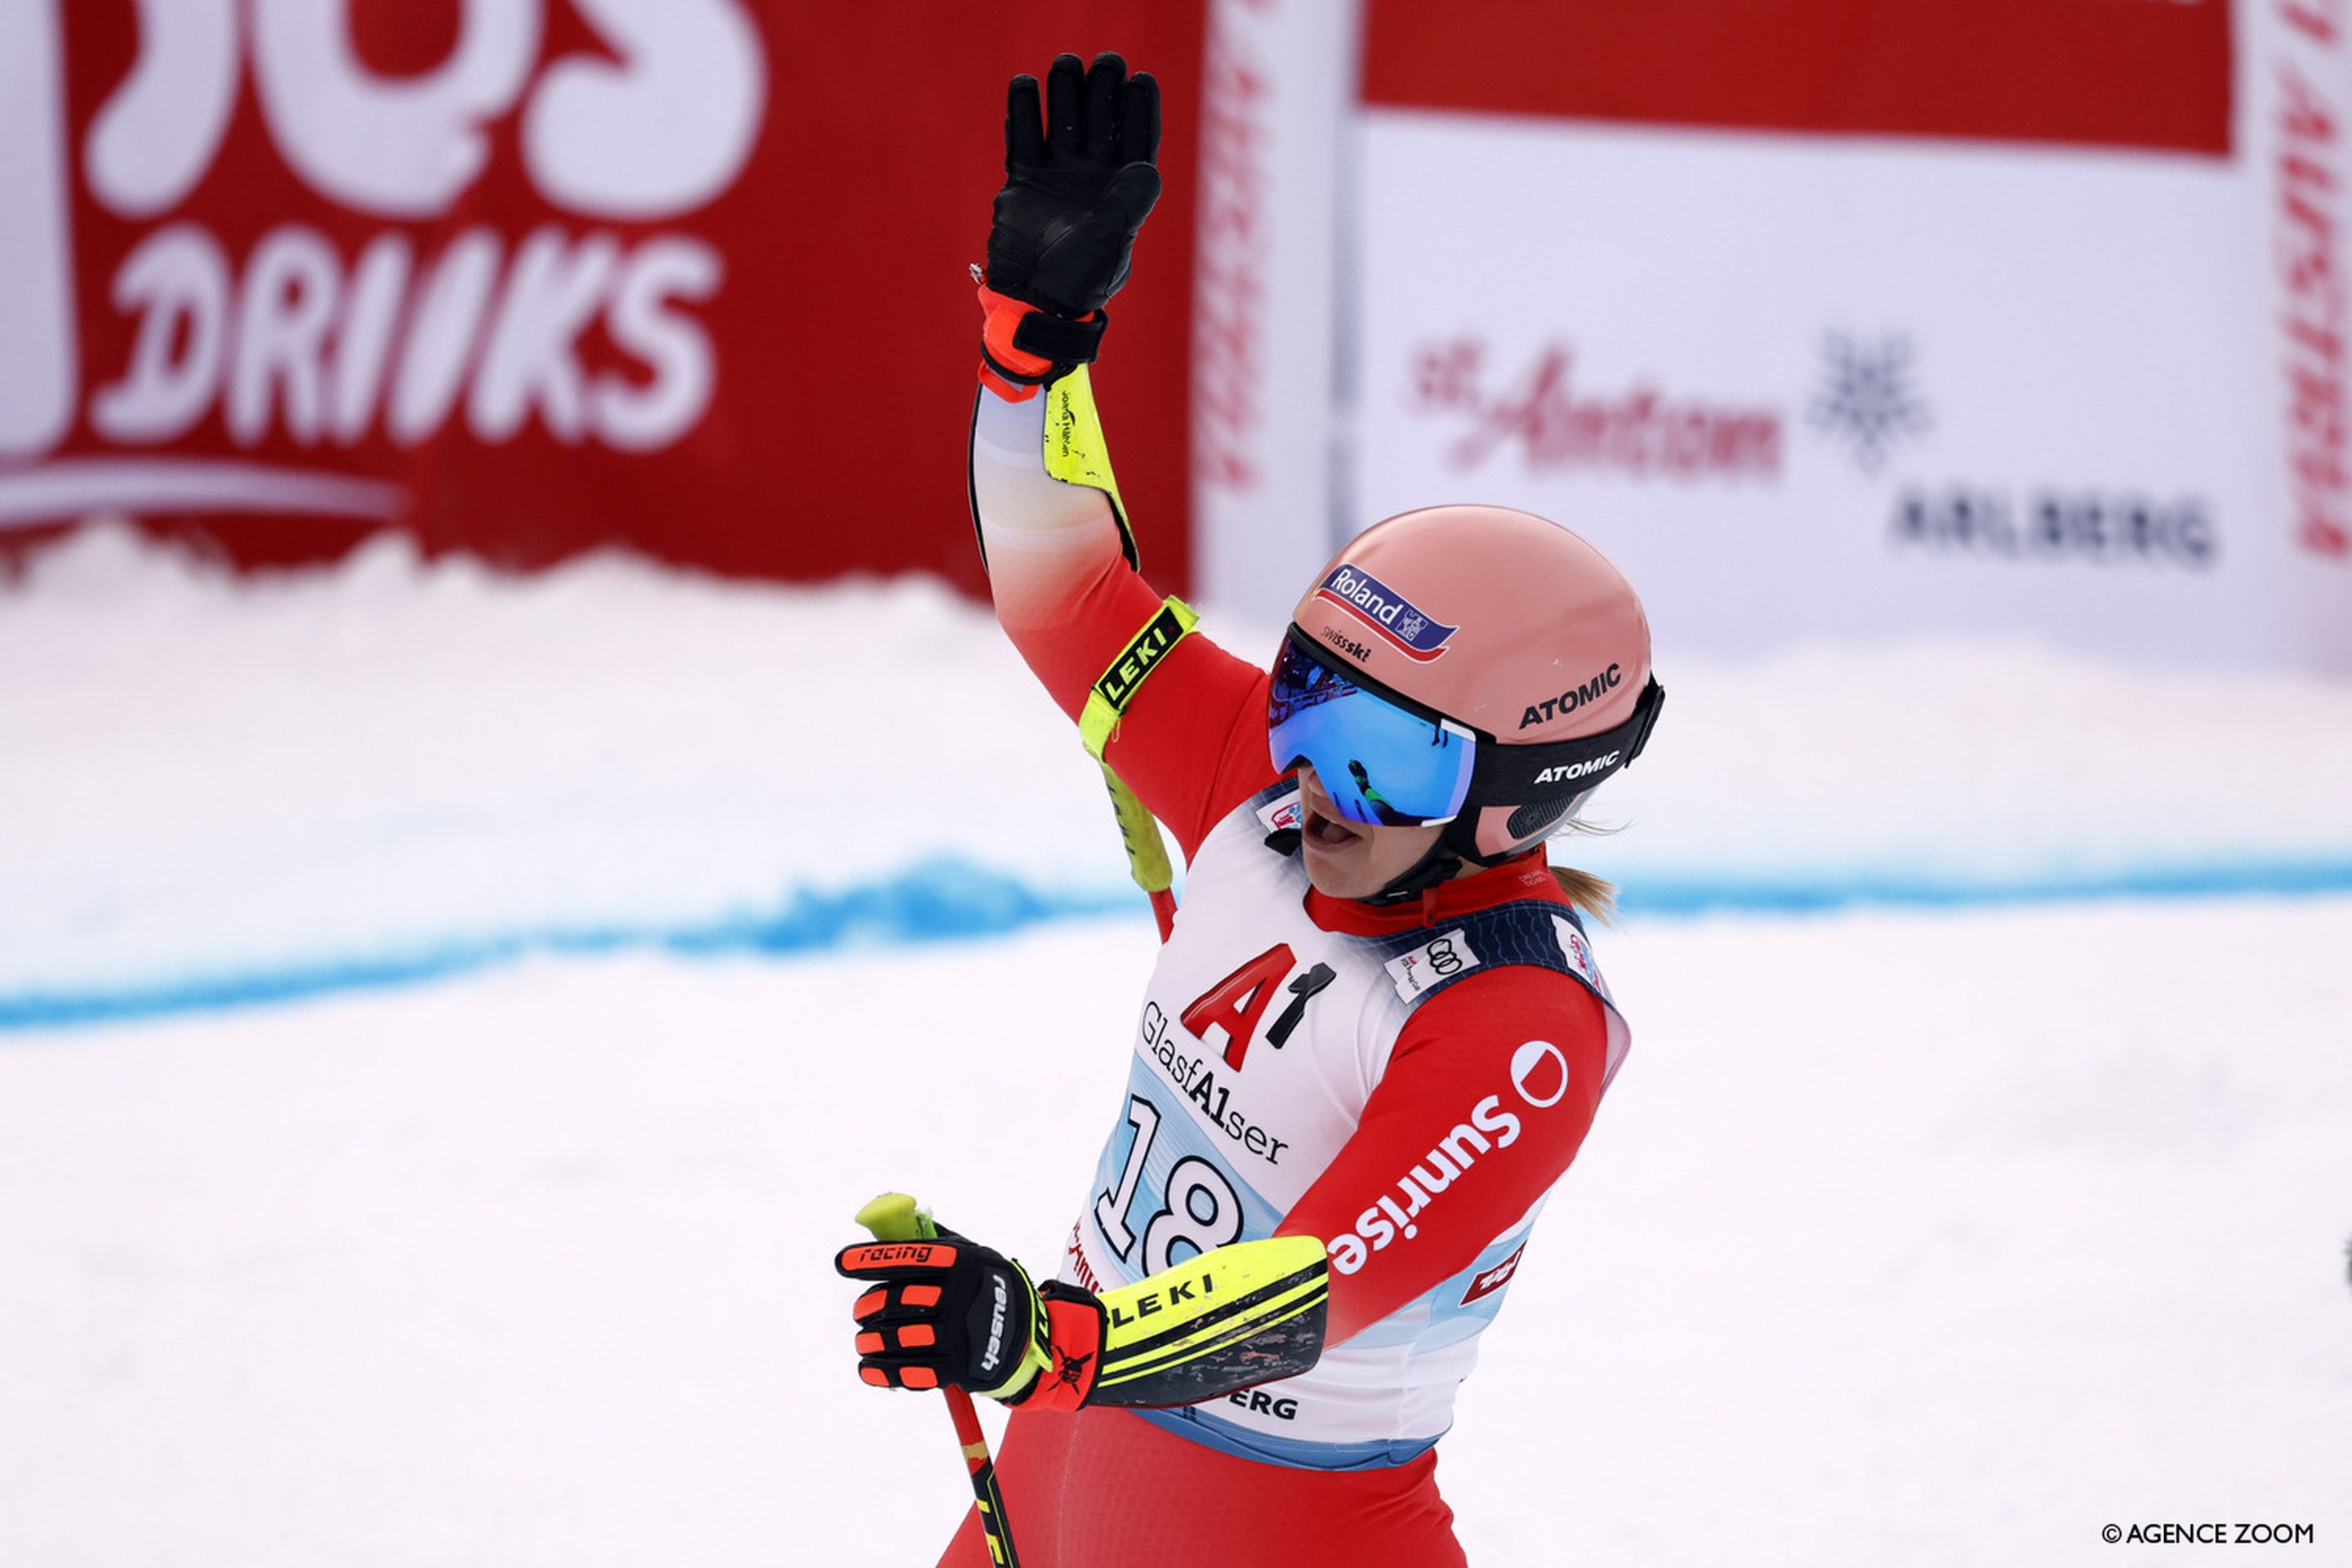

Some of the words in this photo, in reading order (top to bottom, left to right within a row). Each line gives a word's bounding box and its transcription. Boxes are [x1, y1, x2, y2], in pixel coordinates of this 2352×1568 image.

[1889, 484, 2220, 570] ARLBERG
[1331, 568, 1404, 626] Roland
[1104, 627, 1168, 701] LEKI
[1519, 662, 1622, 729] ATOMIC
[1534, 751, 1619, 784] ATOMIC
[1180, 943, 1336, 1072] A1
[1096, 1094, 1244, 1279] 18
[1327, 1094, 1522, 1275] Sunrise
[858, 1245, 933, 1263] racing
[980, 1274, 1008, 1371] reusch
[1111, 1274, 1214, 1329] LEKI
